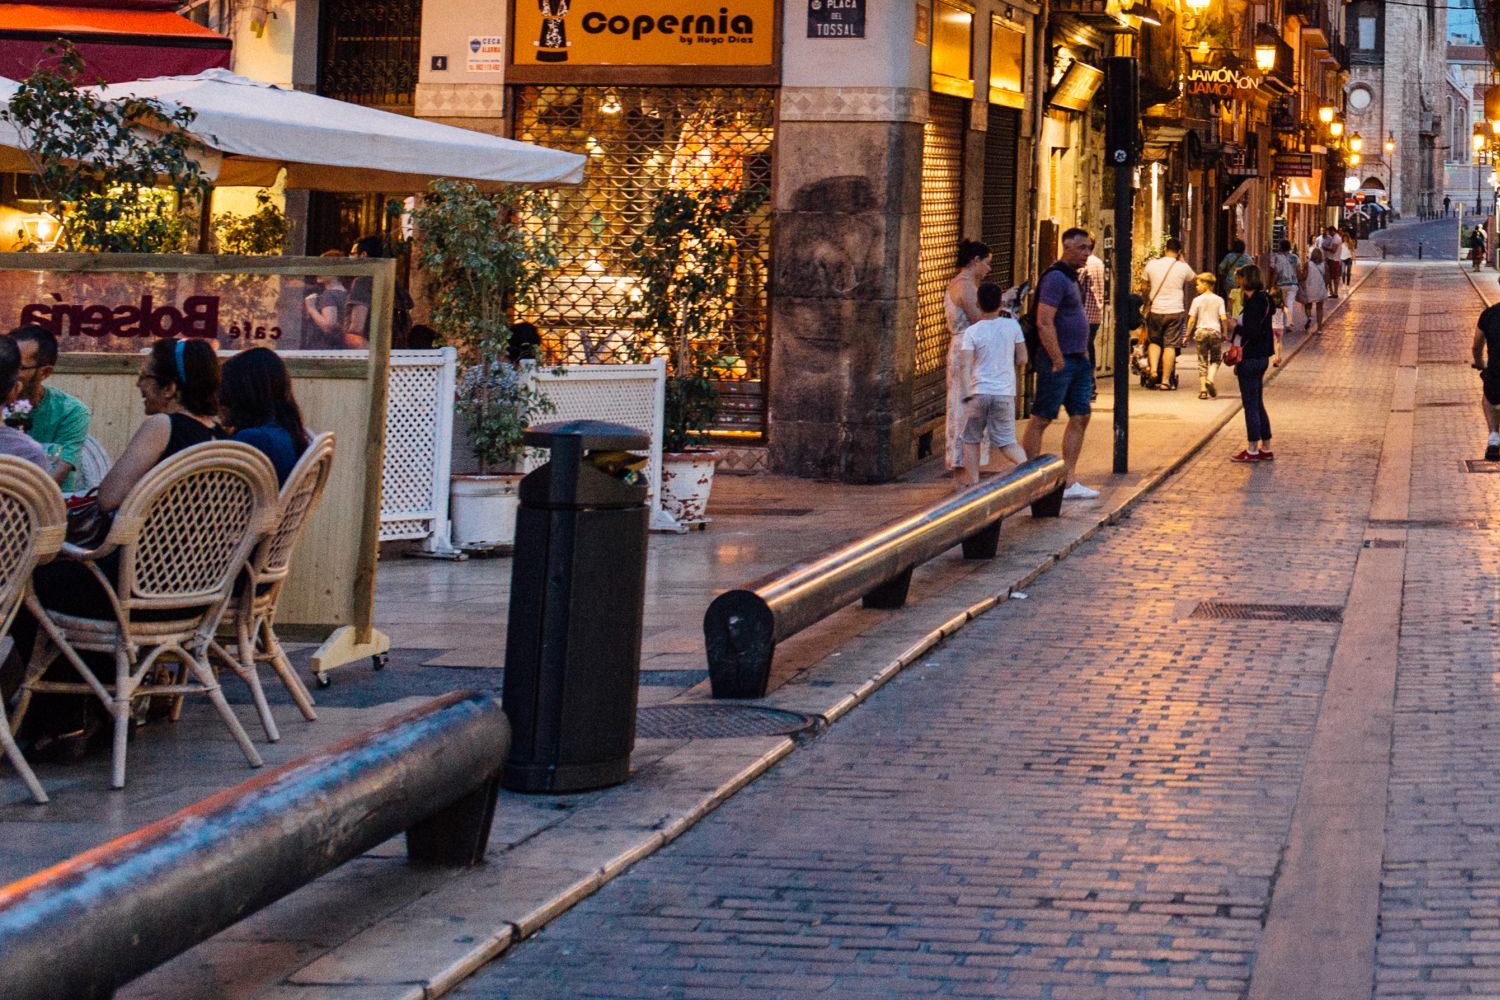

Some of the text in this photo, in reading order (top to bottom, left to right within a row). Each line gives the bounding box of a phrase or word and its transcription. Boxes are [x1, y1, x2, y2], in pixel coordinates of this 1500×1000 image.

[582, 7, 753, 40] Copernia
[817, 23, 856, 36] TOSSAL
[680, 35, 693, 45] by
[697, 35, 725, 45] Hugo
[436, 58, 443, 69] 4
[1188, 66, 1239, 83] JAMÓN
